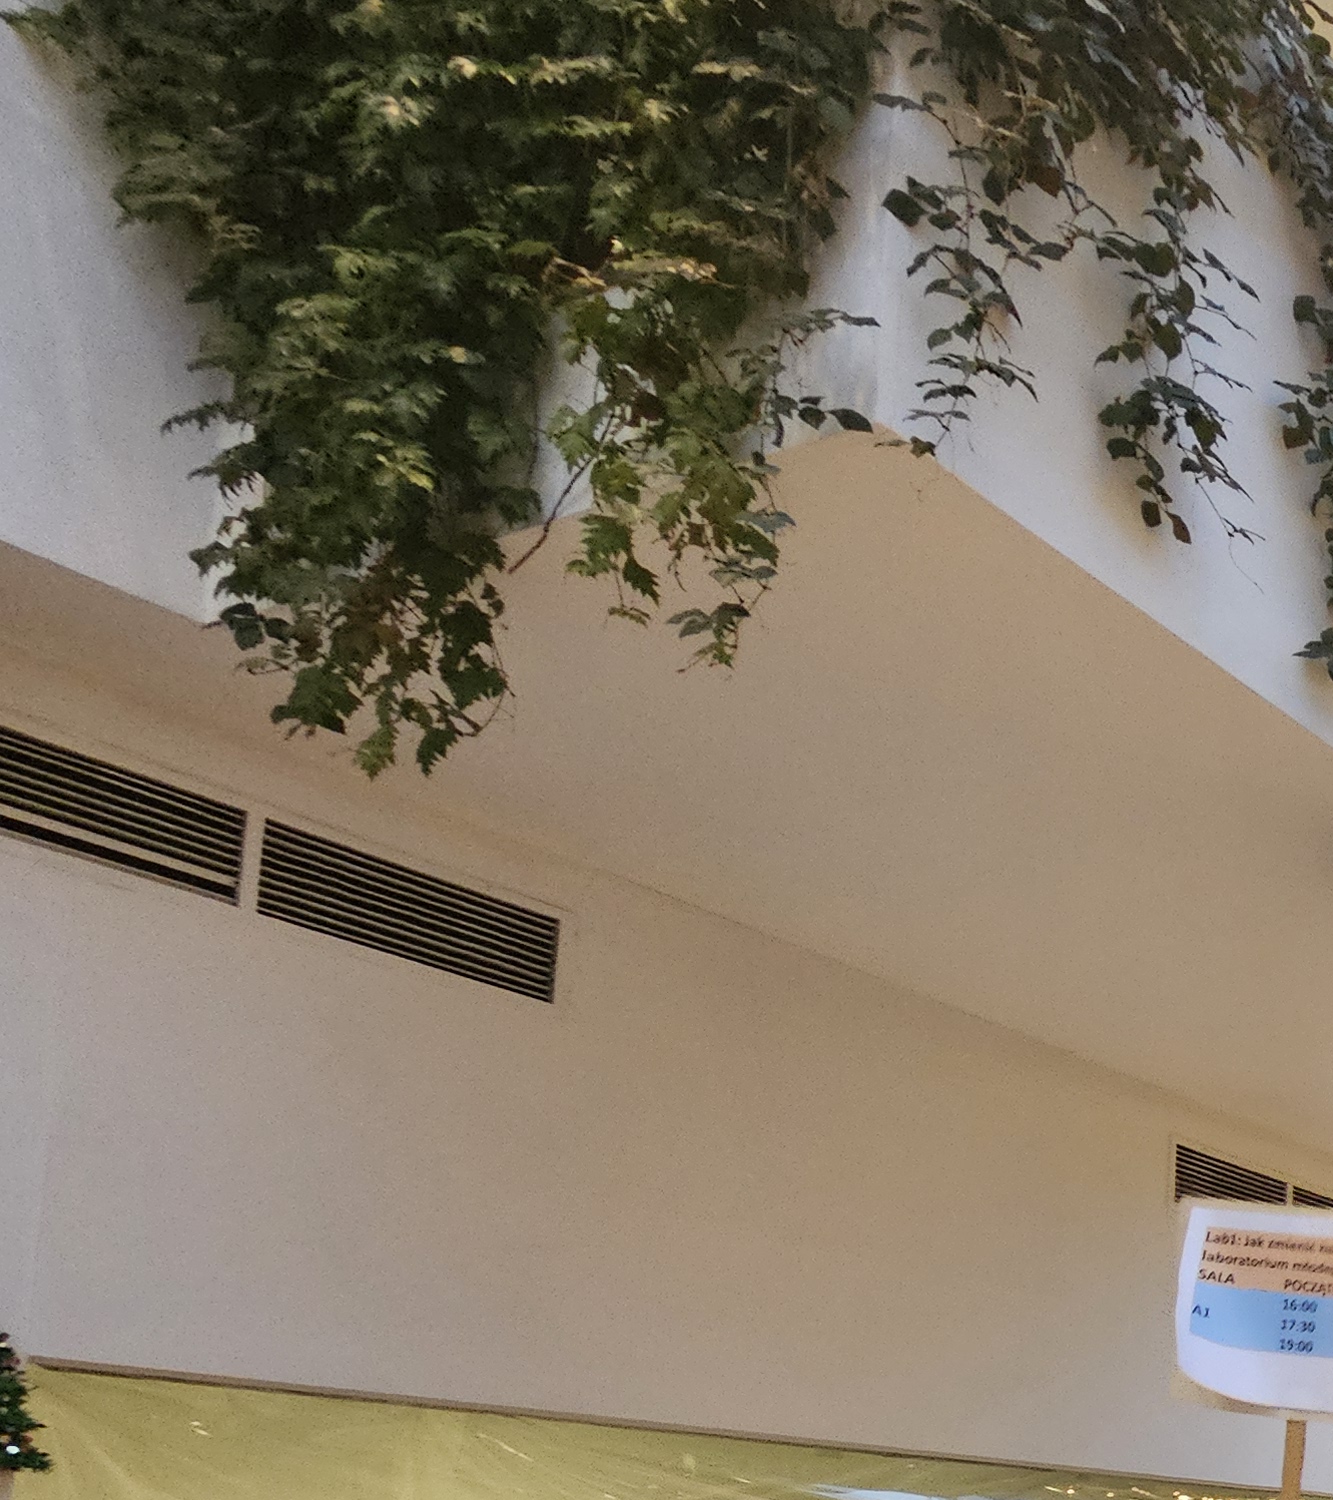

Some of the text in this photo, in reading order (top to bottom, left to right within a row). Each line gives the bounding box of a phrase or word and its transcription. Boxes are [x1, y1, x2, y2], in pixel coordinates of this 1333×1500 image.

[1201, 1250, 1289, 1270] laboratorium
[1197, 1268, 1235, 1285] SALA
[1283, 1299, 1318, 1314] 16:00
[1280, 1319, 1316, 1334] 17:30
[1279, 1338, 1314, 1354] 19:00
